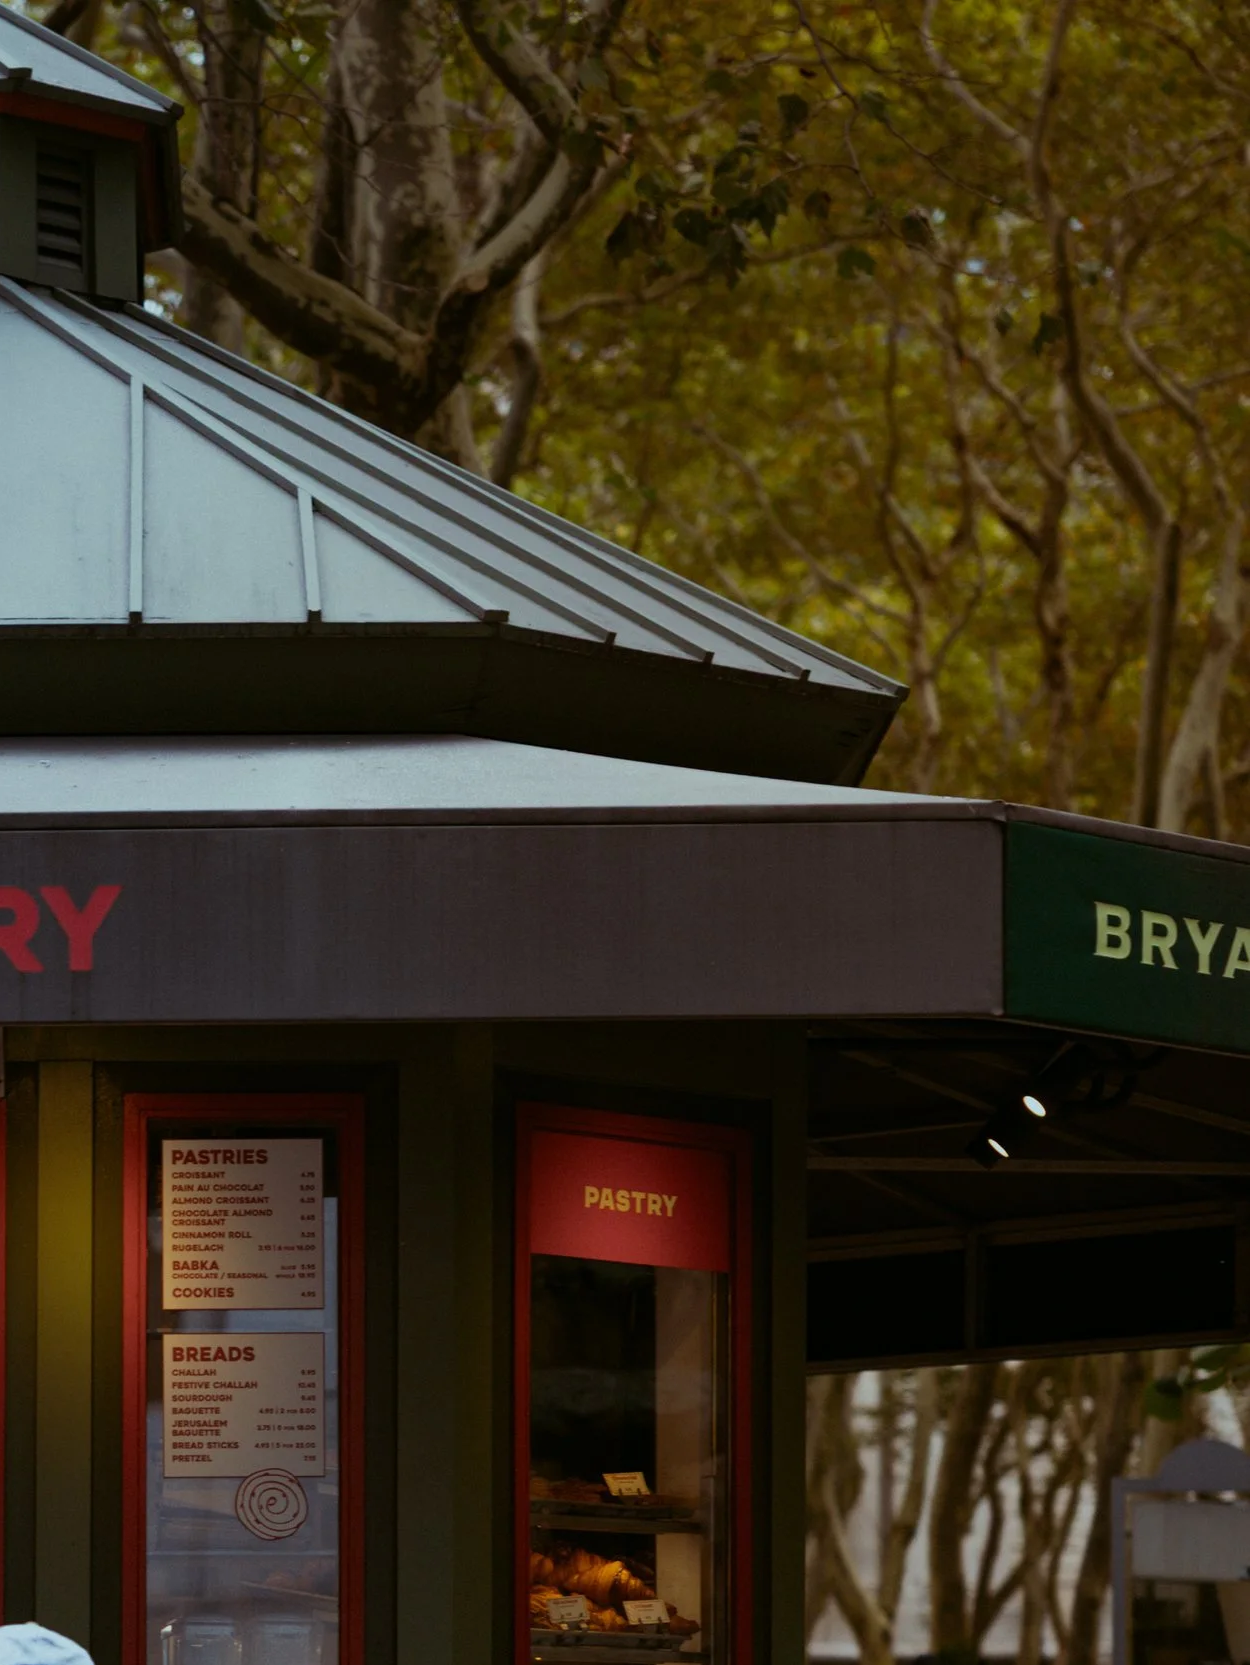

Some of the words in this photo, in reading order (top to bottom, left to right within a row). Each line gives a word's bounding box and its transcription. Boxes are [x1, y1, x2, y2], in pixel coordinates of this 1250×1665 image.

[171, 1149, 268, 1165] PASTRIES
[584, 1186, 678, 1218] PASTRY
[228, 1231, 252, 1239] ROLL
[171, 1244, 224, 1252] RUGELACH
[172, 1261, 219, 1270] BABKA
[172, 1288, 234, 1298] COOKIES
[172, 1347, 256, 1362] BREADS
[213, 1381, 258, 1389] CHALLAH
